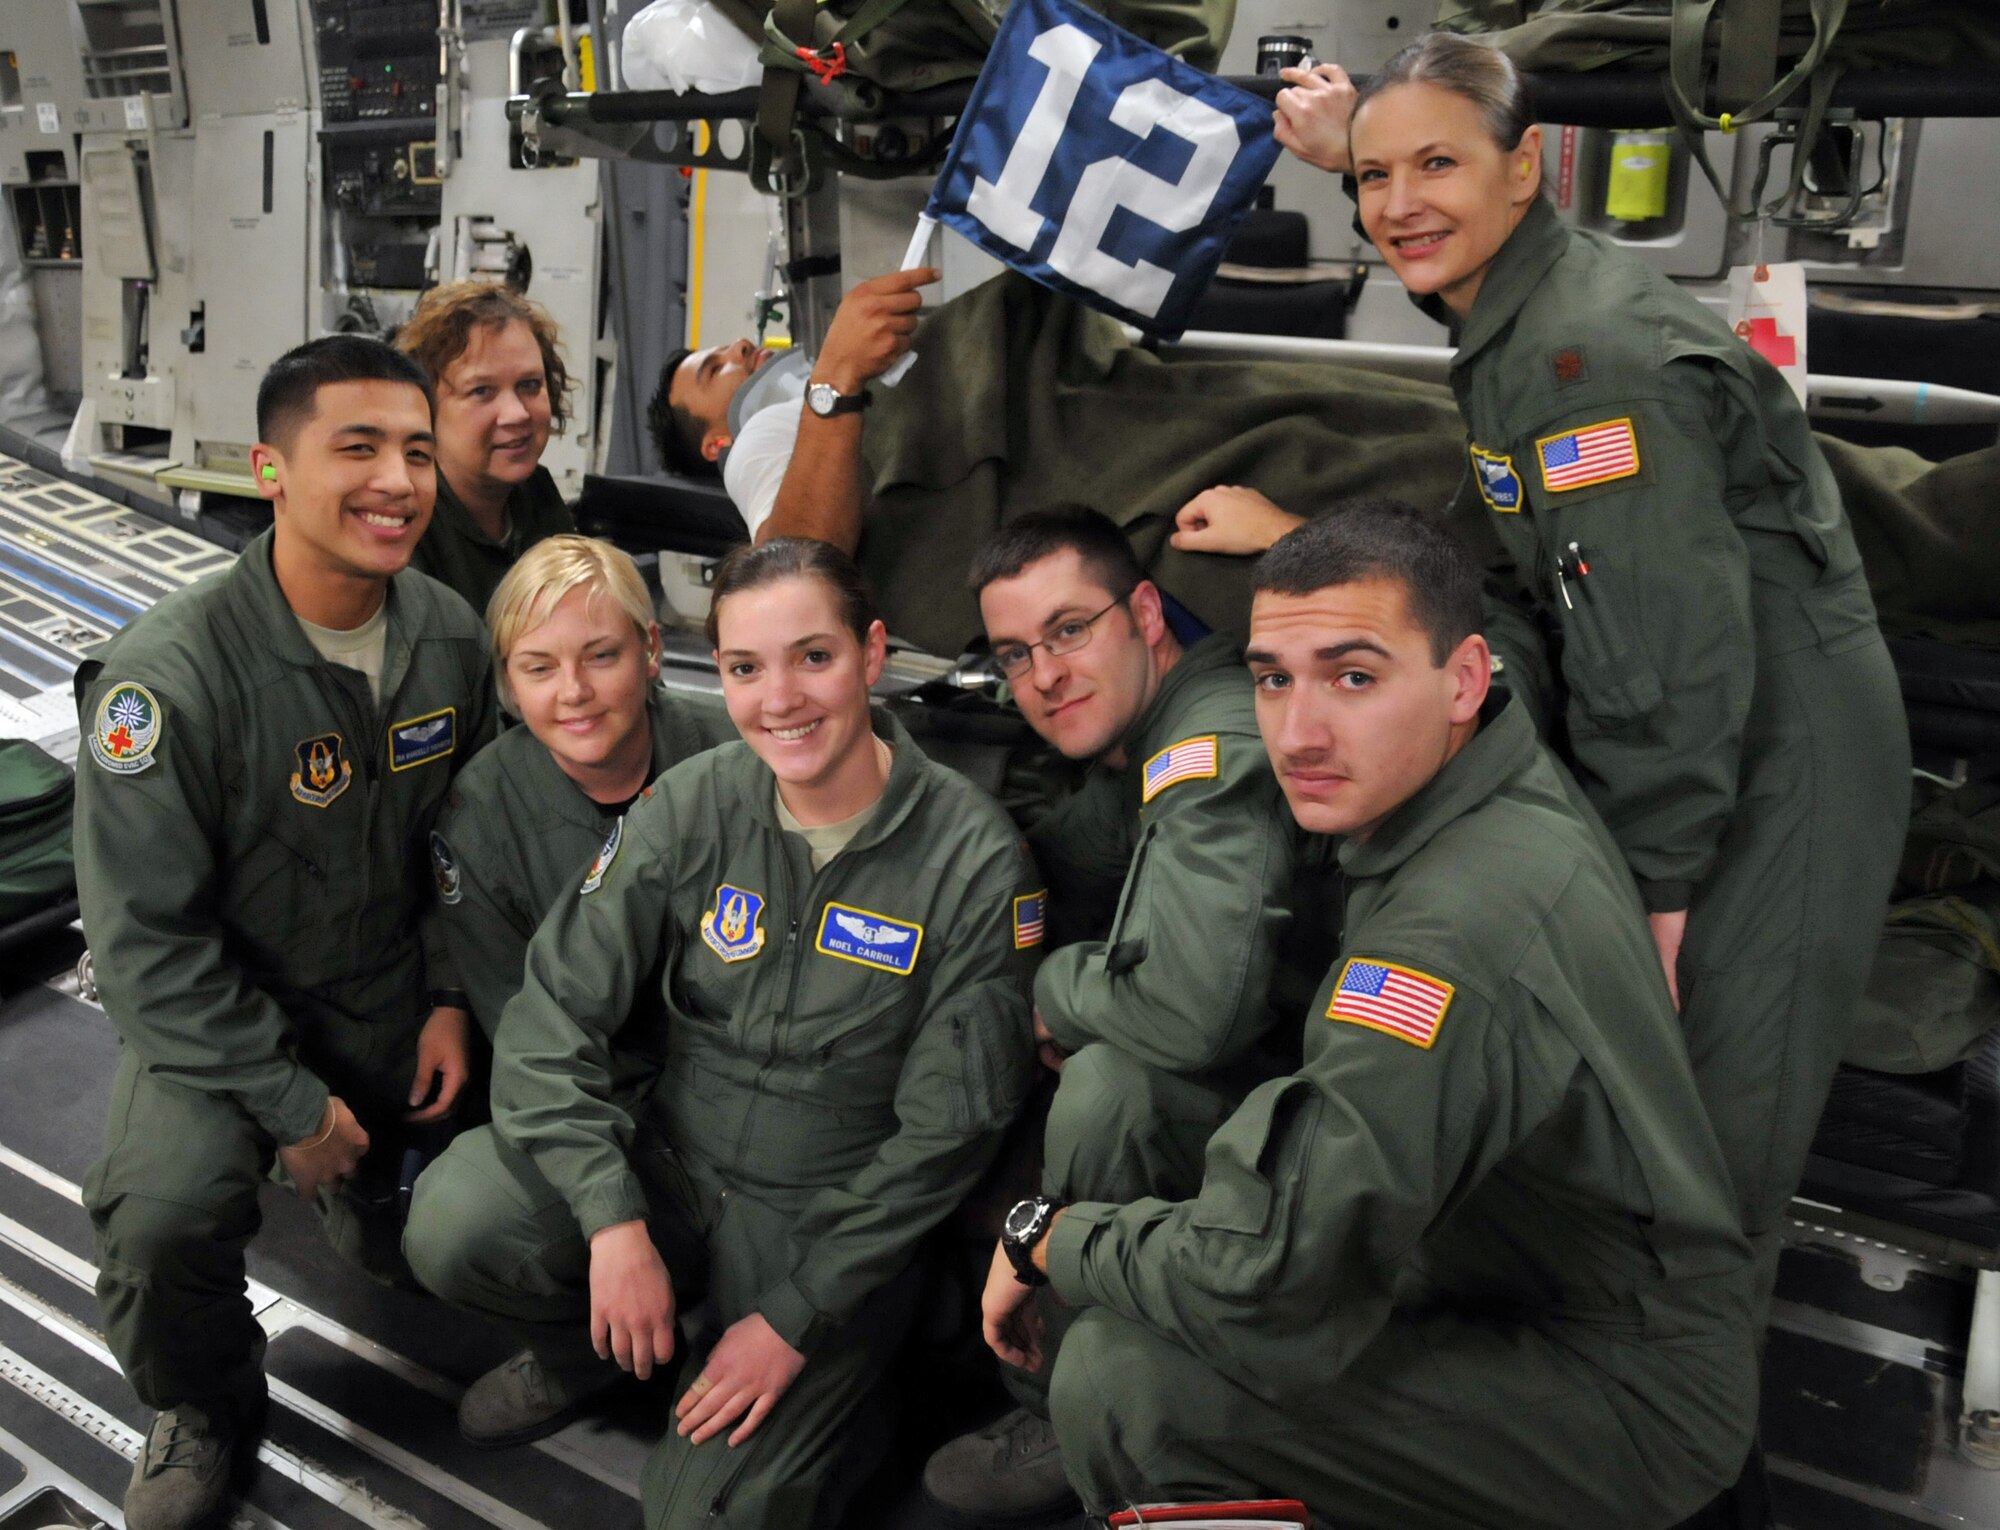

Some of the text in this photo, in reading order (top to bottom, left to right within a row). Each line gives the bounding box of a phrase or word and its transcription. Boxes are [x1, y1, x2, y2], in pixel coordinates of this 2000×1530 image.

[966, 23, 1241, 319] 12
[124, 761, 139, 769] EVAC
[828, 938, 901, 967] NOEL CARROLL
